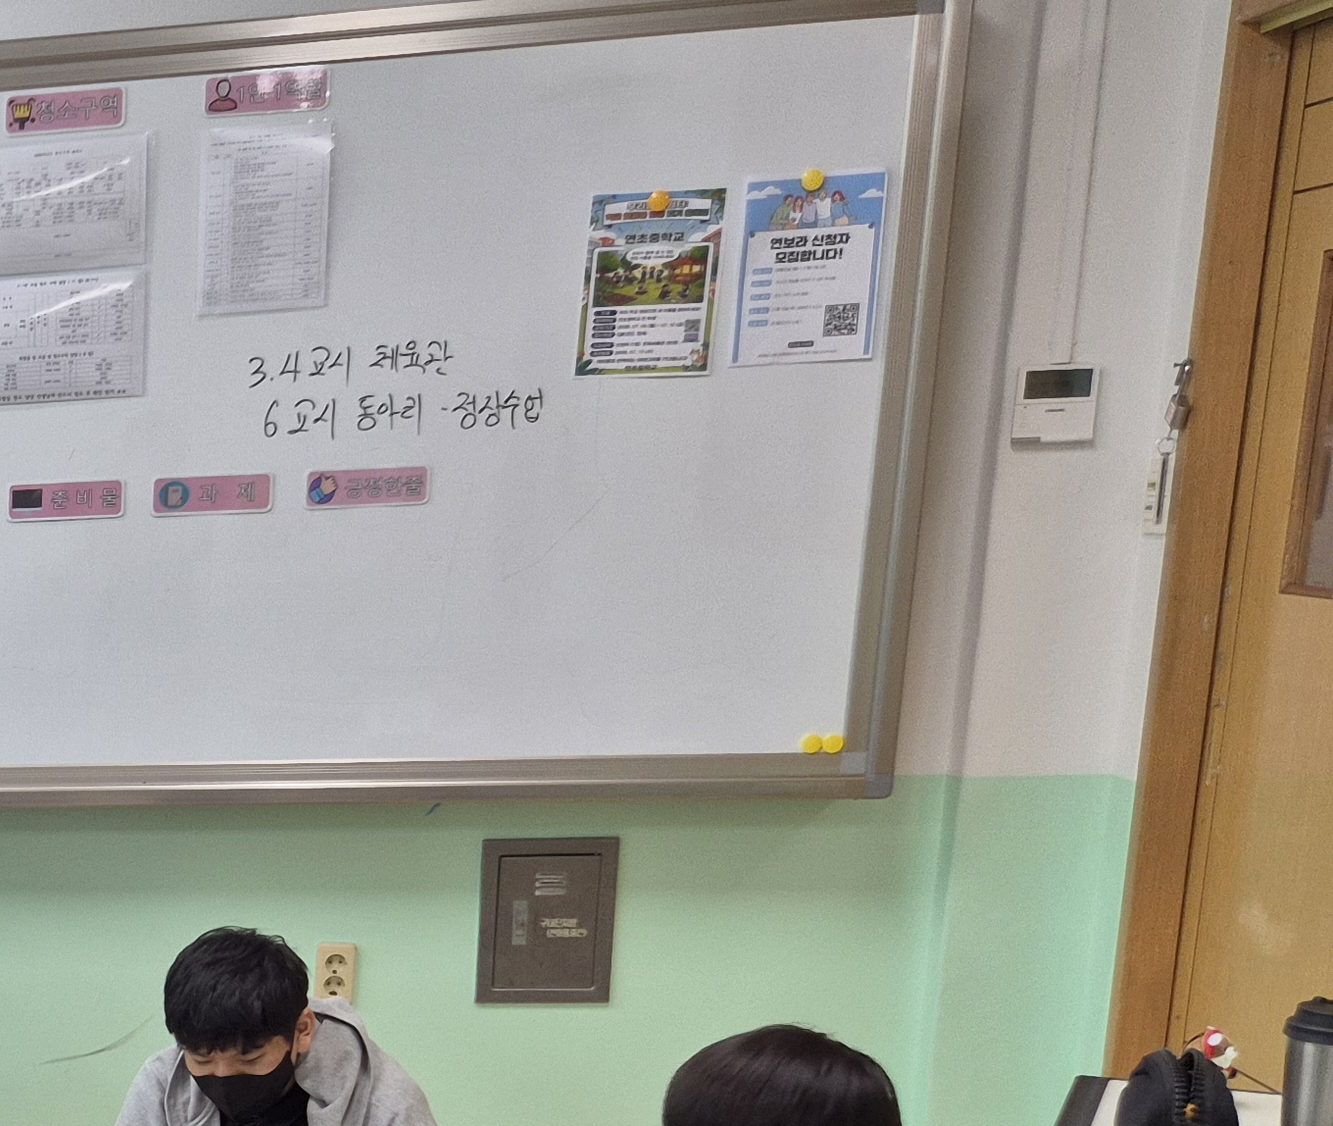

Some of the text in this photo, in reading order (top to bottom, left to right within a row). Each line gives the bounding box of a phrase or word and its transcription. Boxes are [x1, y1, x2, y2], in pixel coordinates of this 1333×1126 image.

[36, 94, 119, 123] 청소구역
[625, 232, 684, 245] 연초중학교
[770, 232, 851, 250] 연보라 신청자
[774, 248, 844, 264] 모집합니다!
[370, 340, 454, 376] 체육관
[357, 393, 422, 435] 동아리
[345, 476, 424, 498] 긍정한줄
